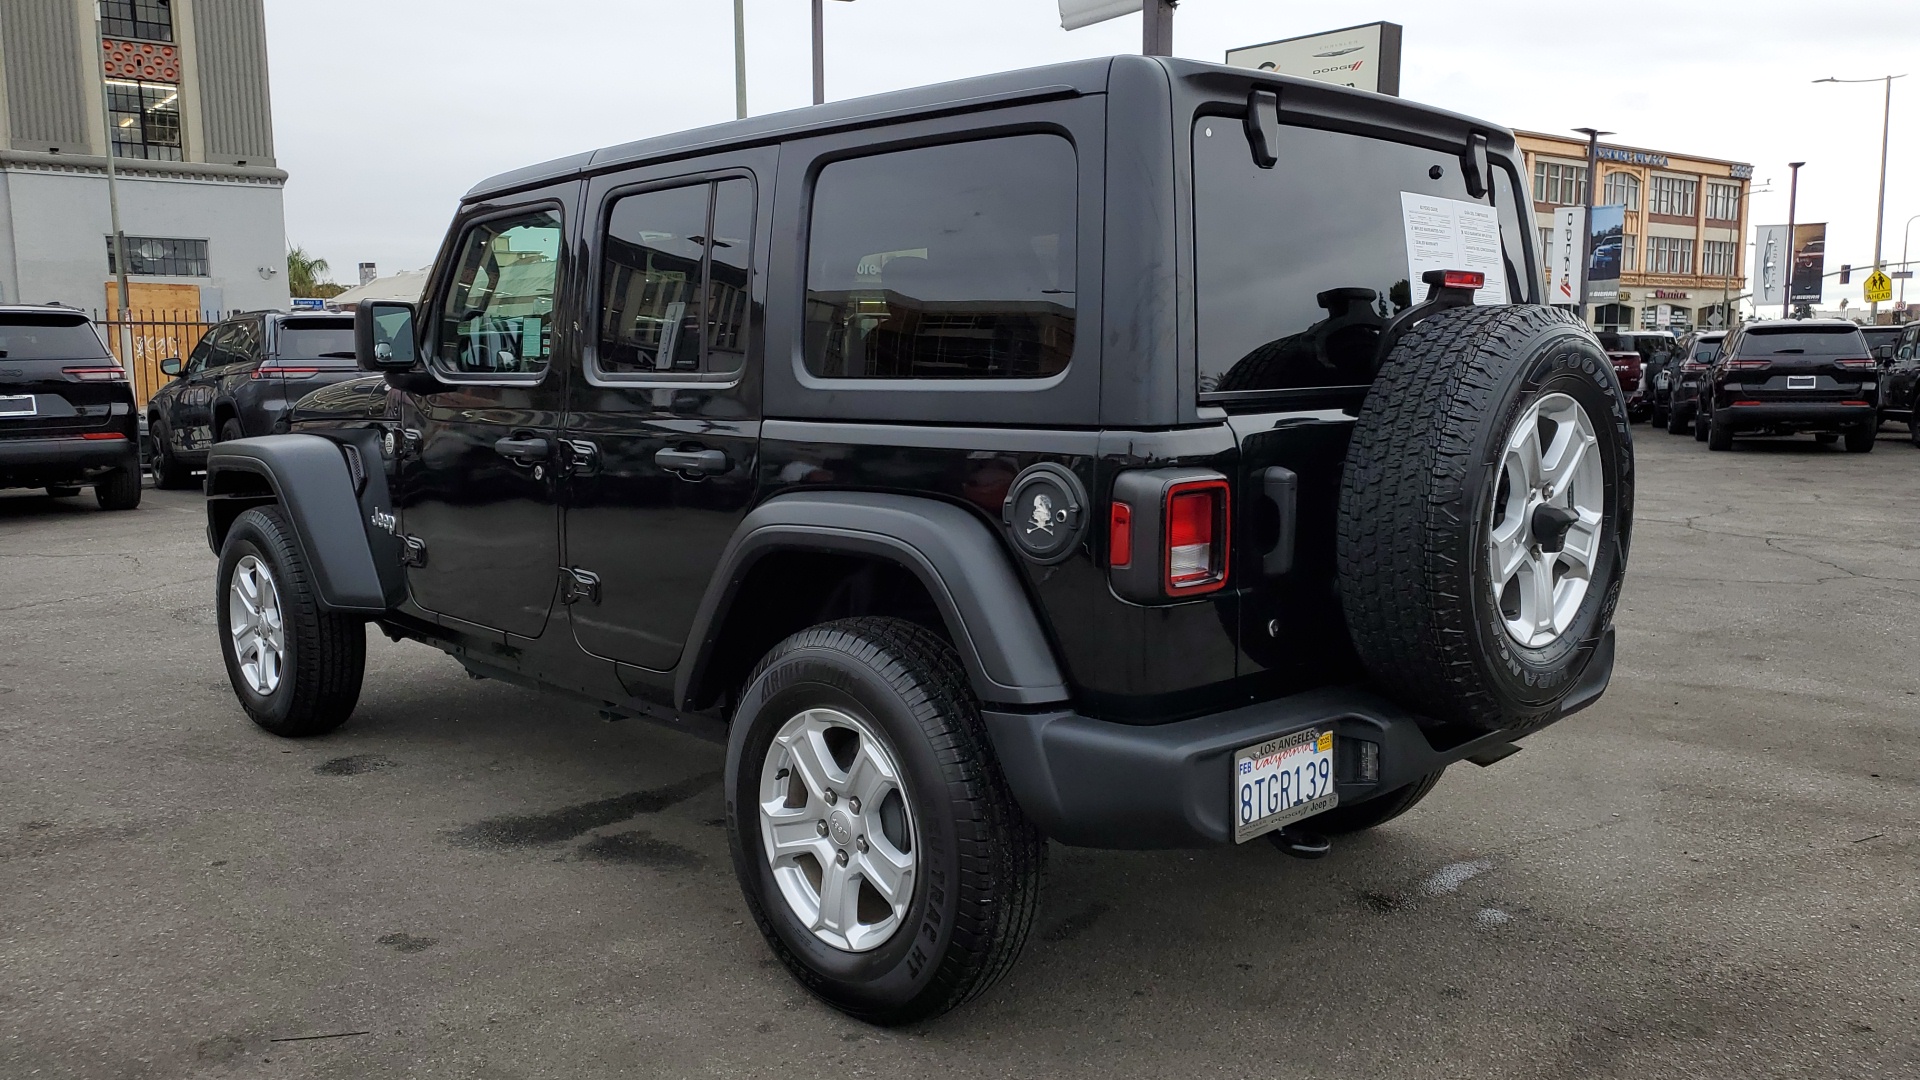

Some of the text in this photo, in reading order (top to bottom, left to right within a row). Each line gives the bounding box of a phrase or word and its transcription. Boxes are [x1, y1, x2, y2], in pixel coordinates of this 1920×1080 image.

[1312, 63, 1356, 75] DODGE
[1867, 291, 1891, 300] AHEAD
[371, 506, 397, 535] Jeep
[1261, 729, 1315, 756] LOS ANGELES
[1255, 741, 1313, 770] California
[1239, 761, 1252, 775] FEB
[1241, 757, 1330, 825] 8TGR139
[1310, 800, 1327, 812] Jeep
